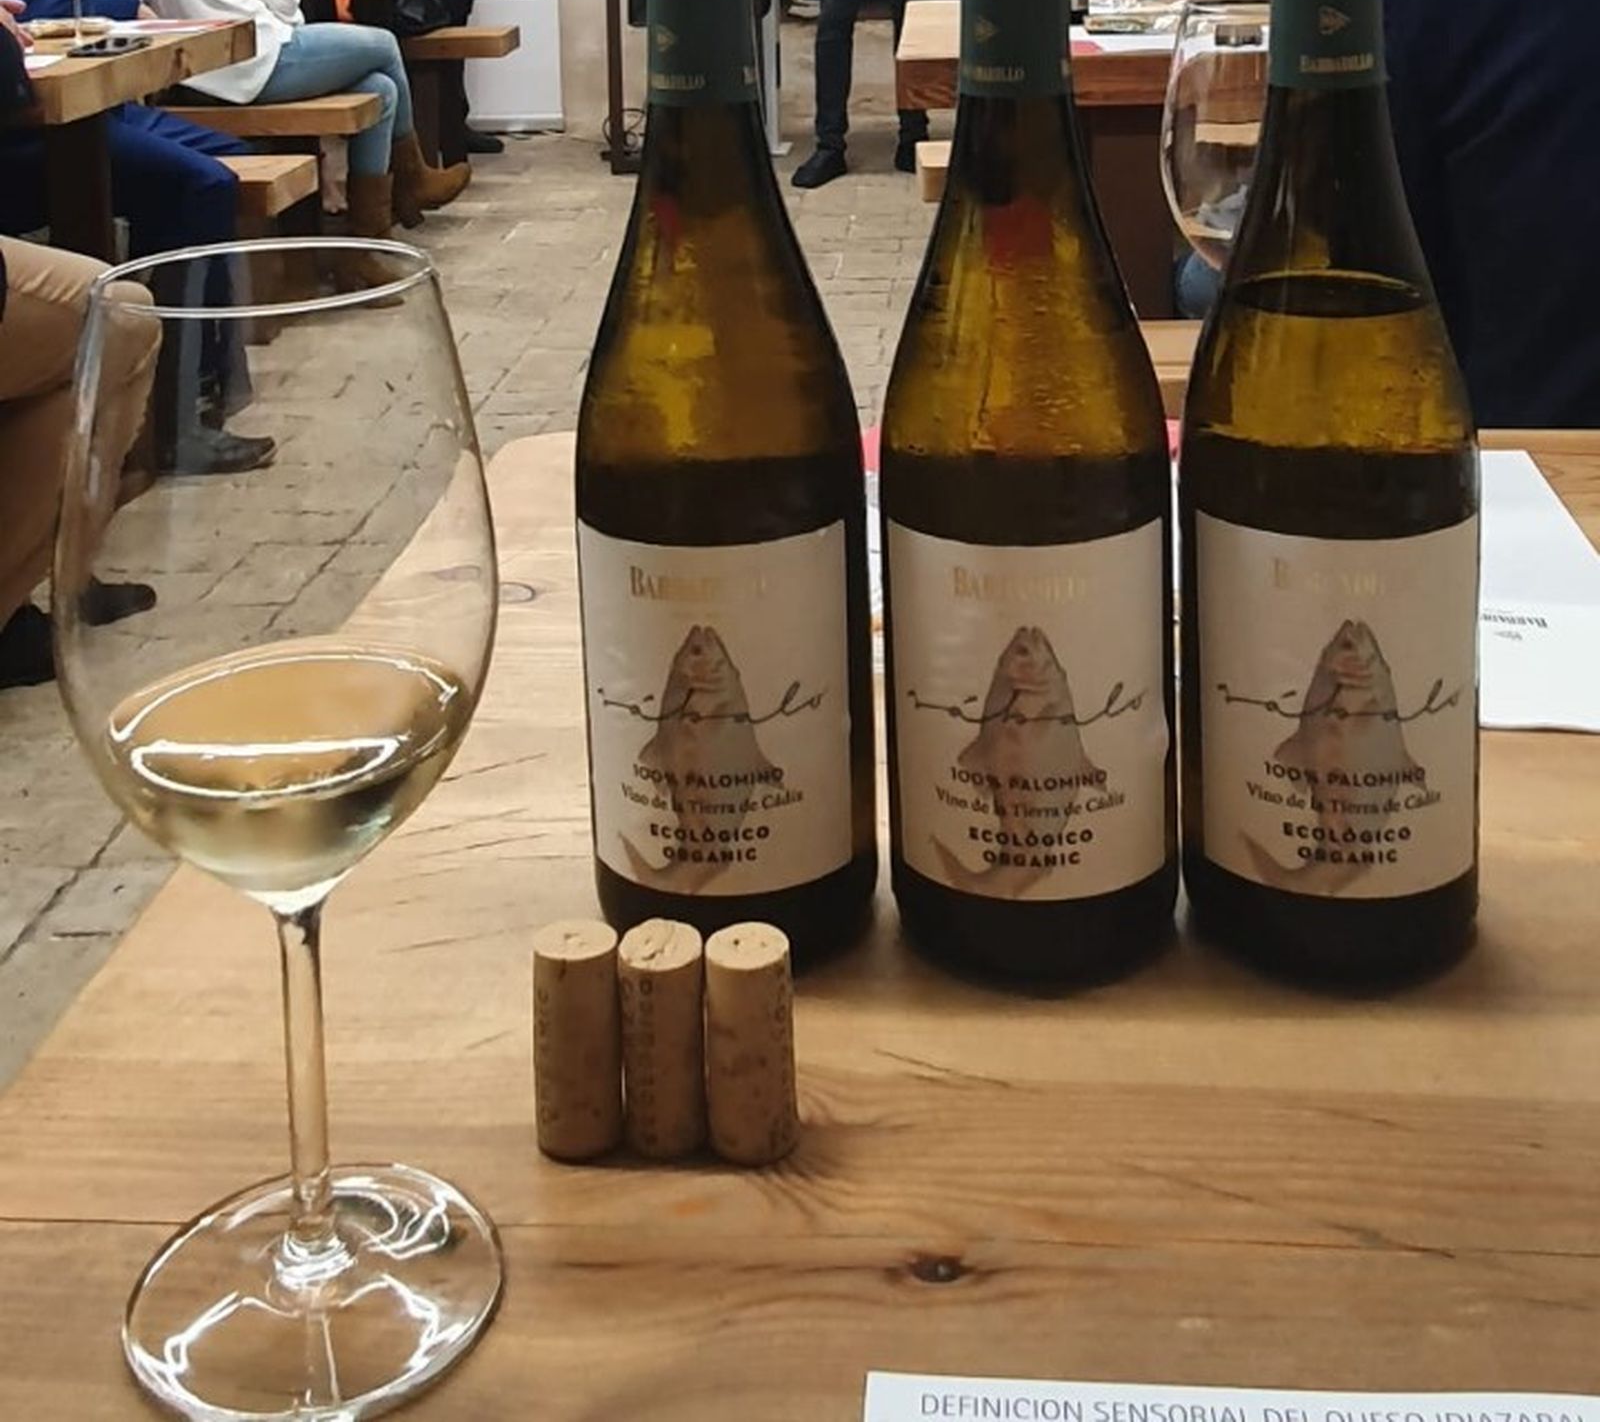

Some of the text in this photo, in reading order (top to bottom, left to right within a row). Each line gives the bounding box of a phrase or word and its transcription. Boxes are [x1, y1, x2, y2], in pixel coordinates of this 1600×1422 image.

[685, 767, 784, 789] PALOMINO
[1009, 769, 1108, 792] PALOMINO
[1326, 766, 1426, 789] PALOMINO
[621, 782, 649, 806] Vino
[650, 795, 668, 811] de
[688, 799, 736, 815] Tierra
[738, 797, 759, 814] de
[935, 785, 969, 809] Vino
[970, 798, 989, 815] de
[1013, 802, 1060, 819] Tierra
[1063, 801, 1083, 817] de
[1246, 780, 1283, 805] Vino
[1285, 793, 1305, 810] de
[1330, 799, 1380, 816] Tierra
[1382, 798, 1401, 814] de
[662, 846, 757, 864] ORGANIC
[982, 849, 1081, 868] ORGANIC
[1297, 845, 1398, 864] ORGANIC
[921, 1393, 1083, 1422] DEFINICION
[1093, 1401, 1246, 1422] SENSORIAL
